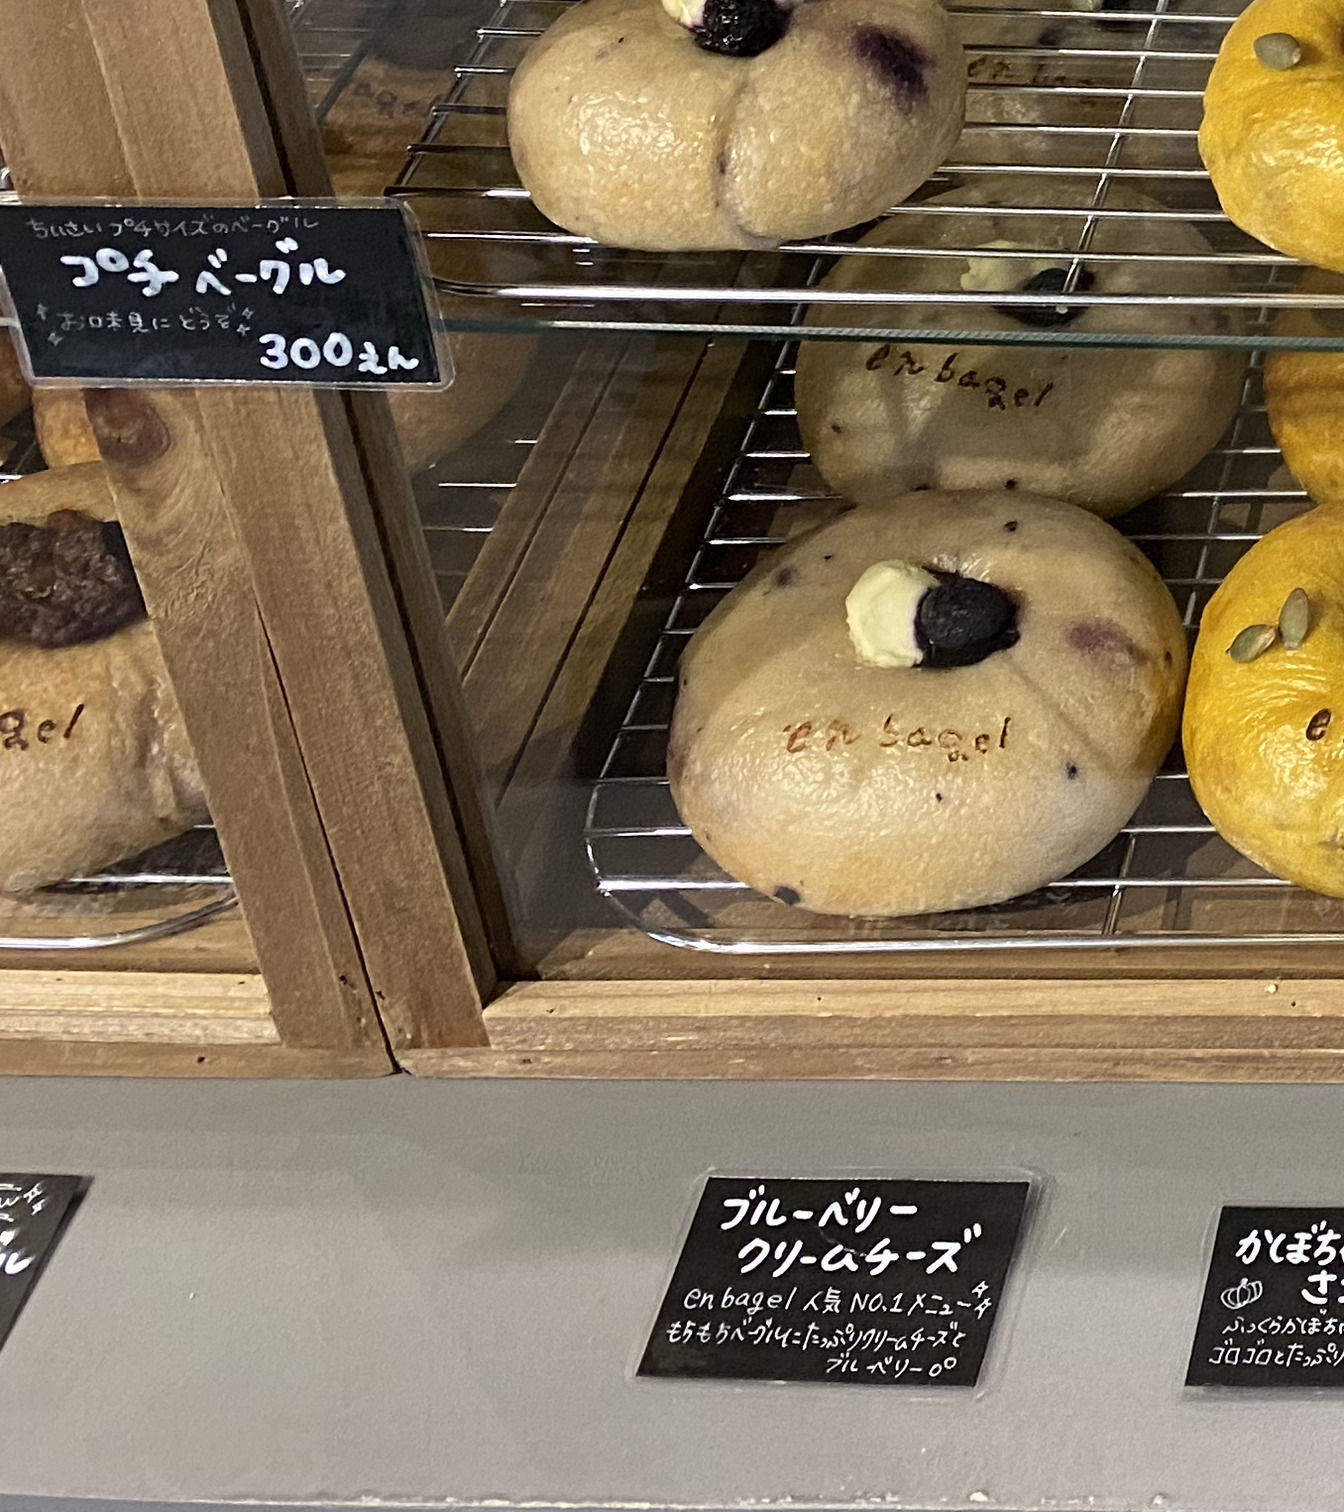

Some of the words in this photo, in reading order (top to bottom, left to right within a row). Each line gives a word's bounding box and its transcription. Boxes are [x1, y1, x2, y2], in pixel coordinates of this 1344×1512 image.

[258, 332, 420, 375] 300えん
[720, 1185, 918, 1233] ブルーベリー
[738, 1223, 983, 1278] クリームチーズ
[683, 1287, 715, 1311] en
[720, 1286, 798, 1315] bagel
[826, 1352, 924, 1379] ブルーベリー
